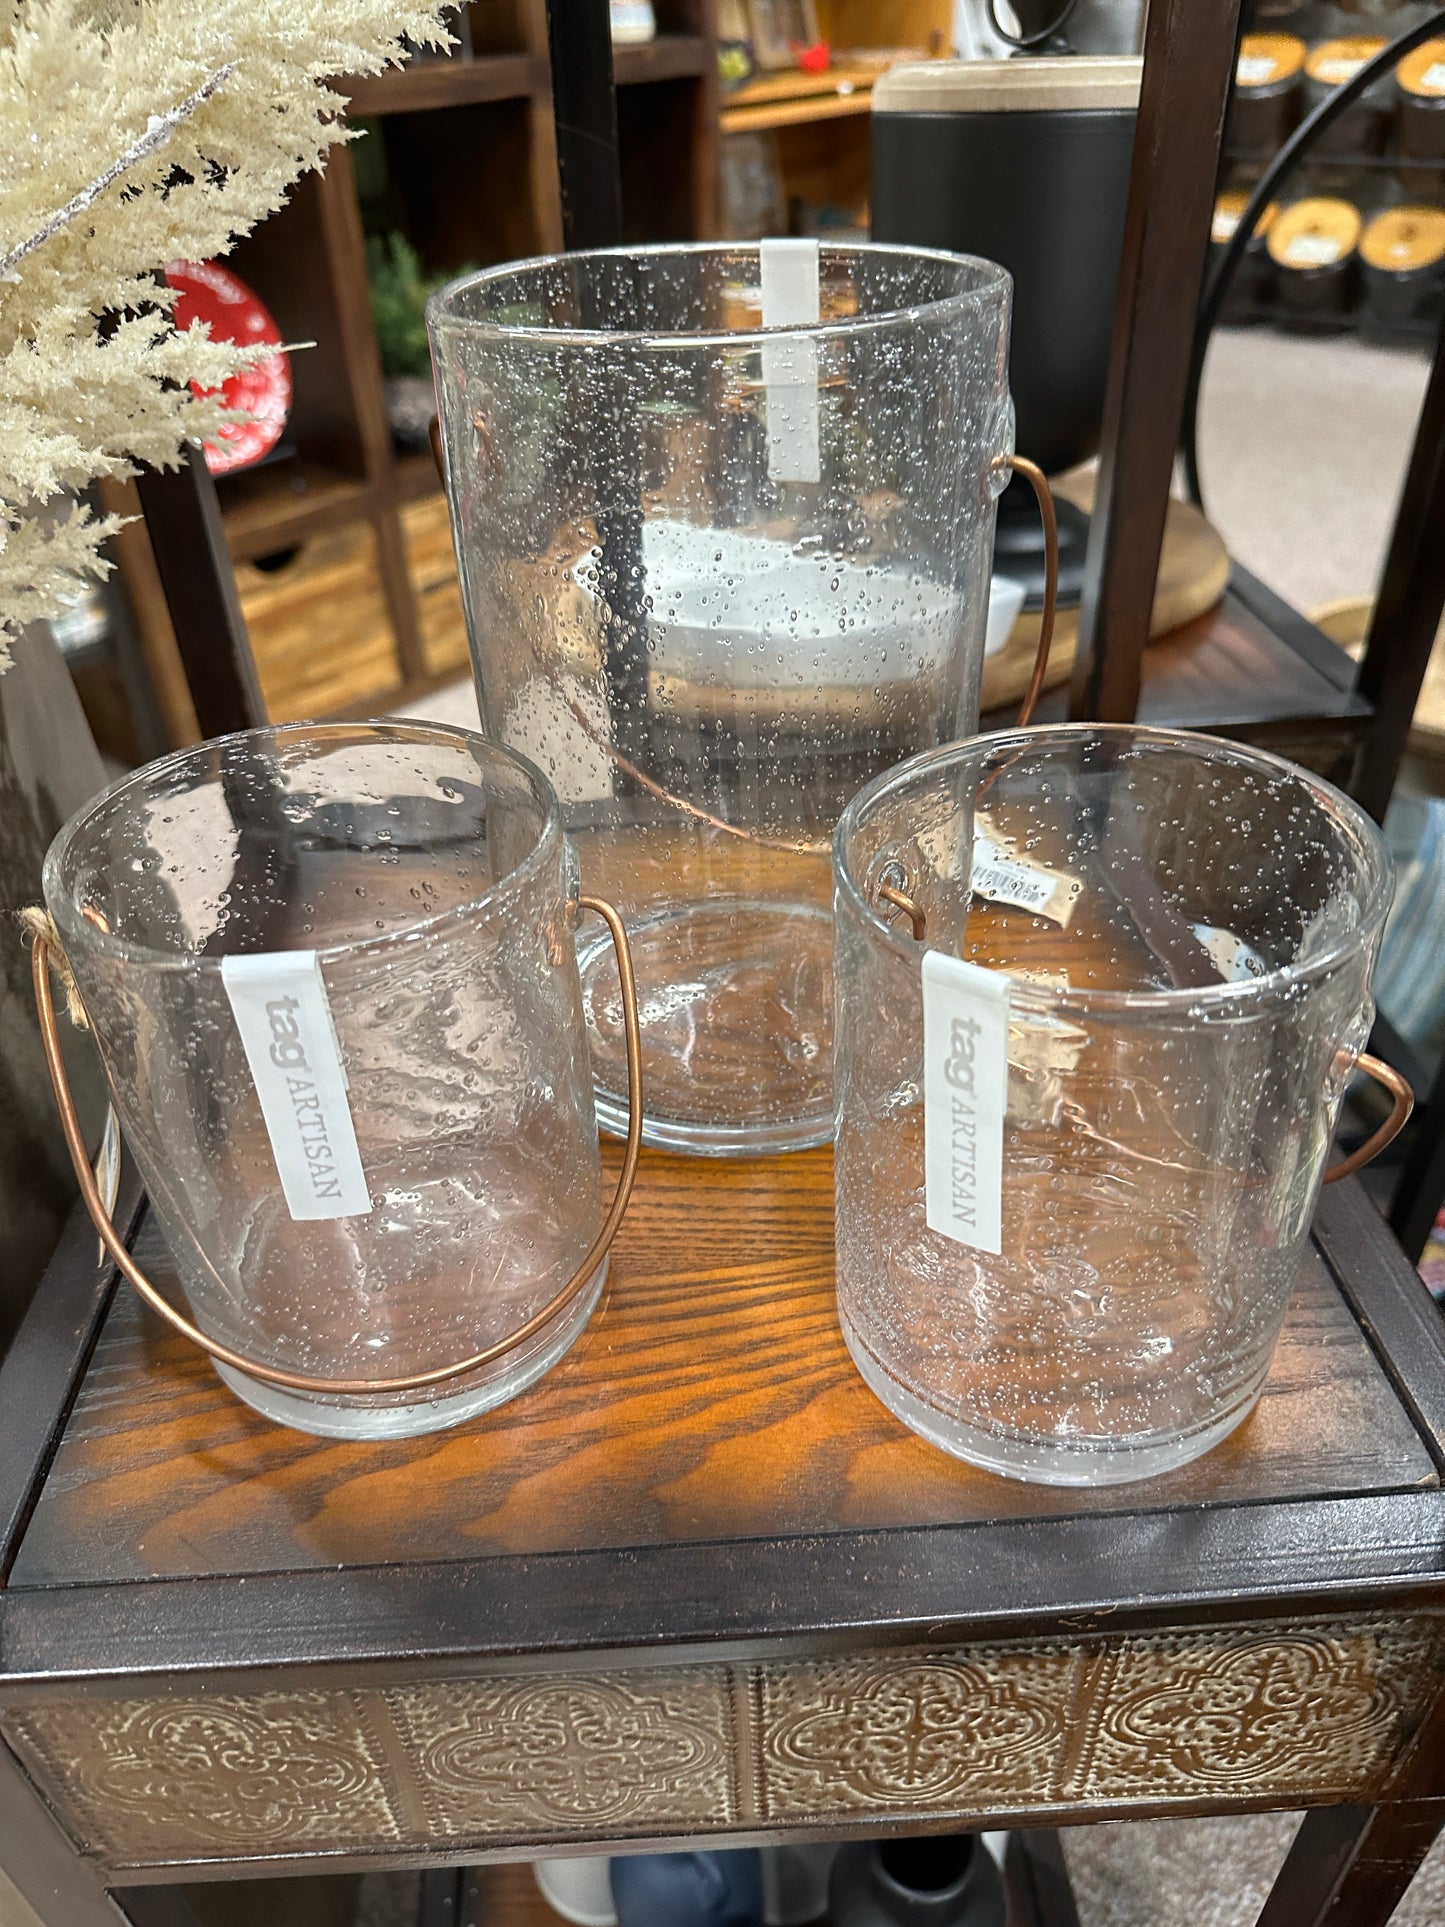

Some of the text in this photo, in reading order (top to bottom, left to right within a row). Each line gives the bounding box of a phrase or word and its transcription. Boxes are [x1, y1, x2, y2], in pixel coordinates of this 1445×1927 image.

[266, 996, 342, 1200] tag ARTISAN
[944, 1016, 982, 1228] tag ARTISAN
